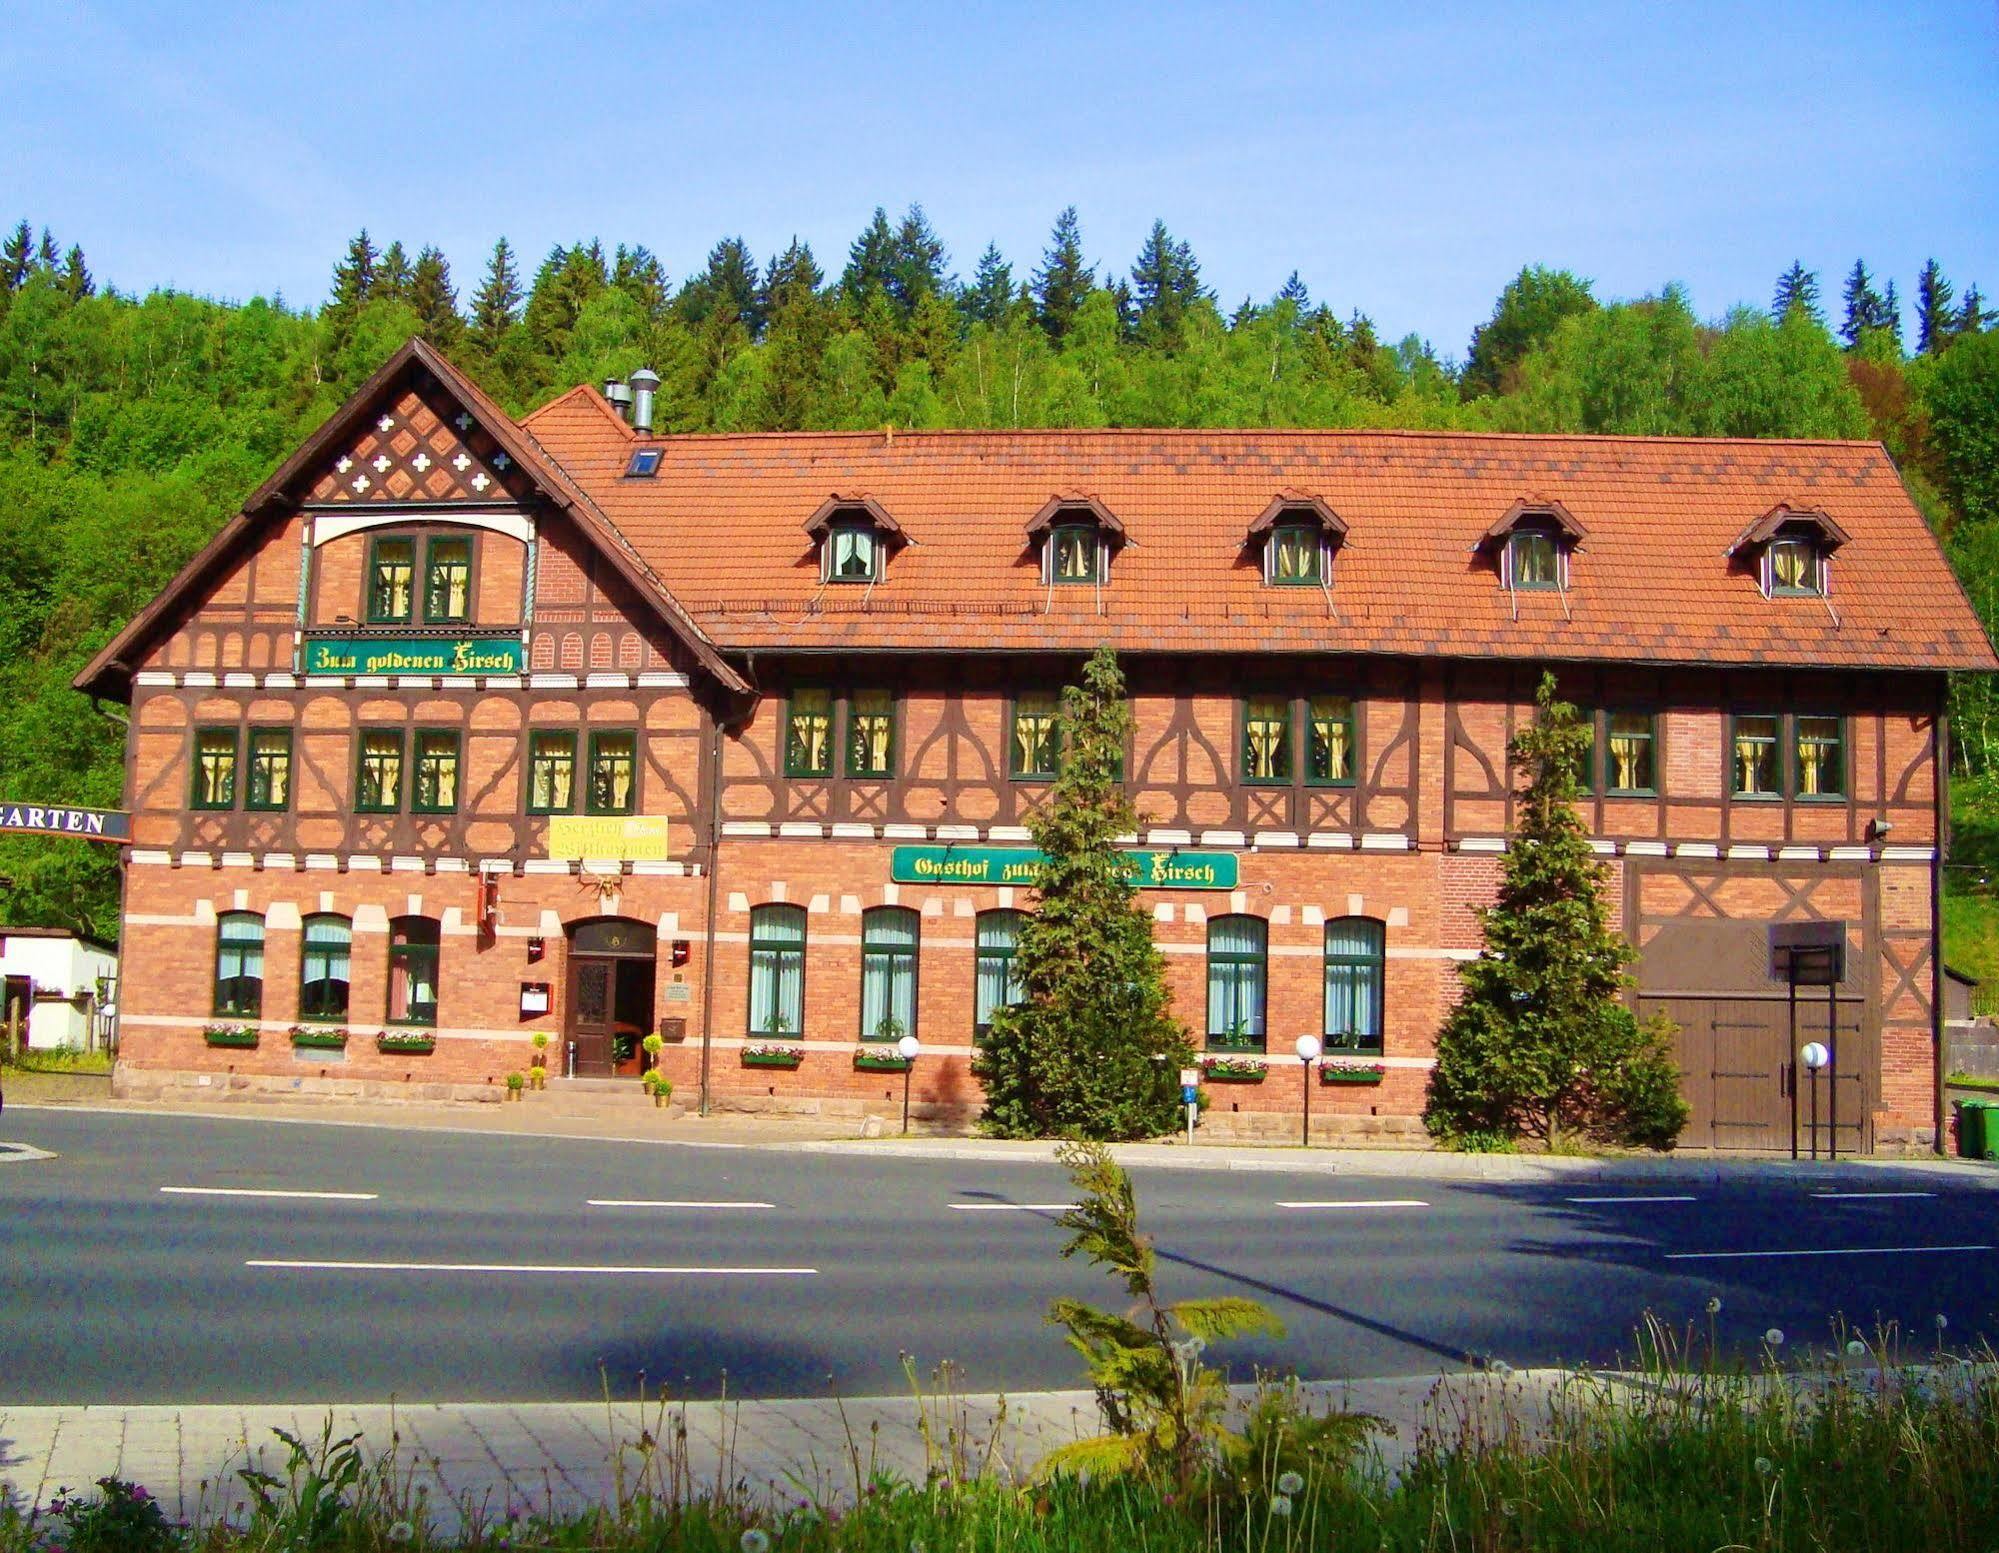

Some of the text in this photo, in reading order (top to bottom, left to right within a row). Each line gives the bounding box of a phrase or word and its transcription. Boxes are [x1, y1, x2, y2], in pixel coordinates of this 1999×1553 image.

[315, 640, 514, 673] Zum goldenen Hirsch
[0, 806, 105, 834] ARTEN
[914, 857, 989, 879] Gasthof
[1002, 862, 1040, 880] zum
[1151, 852, 1215, 883] Hirsch
